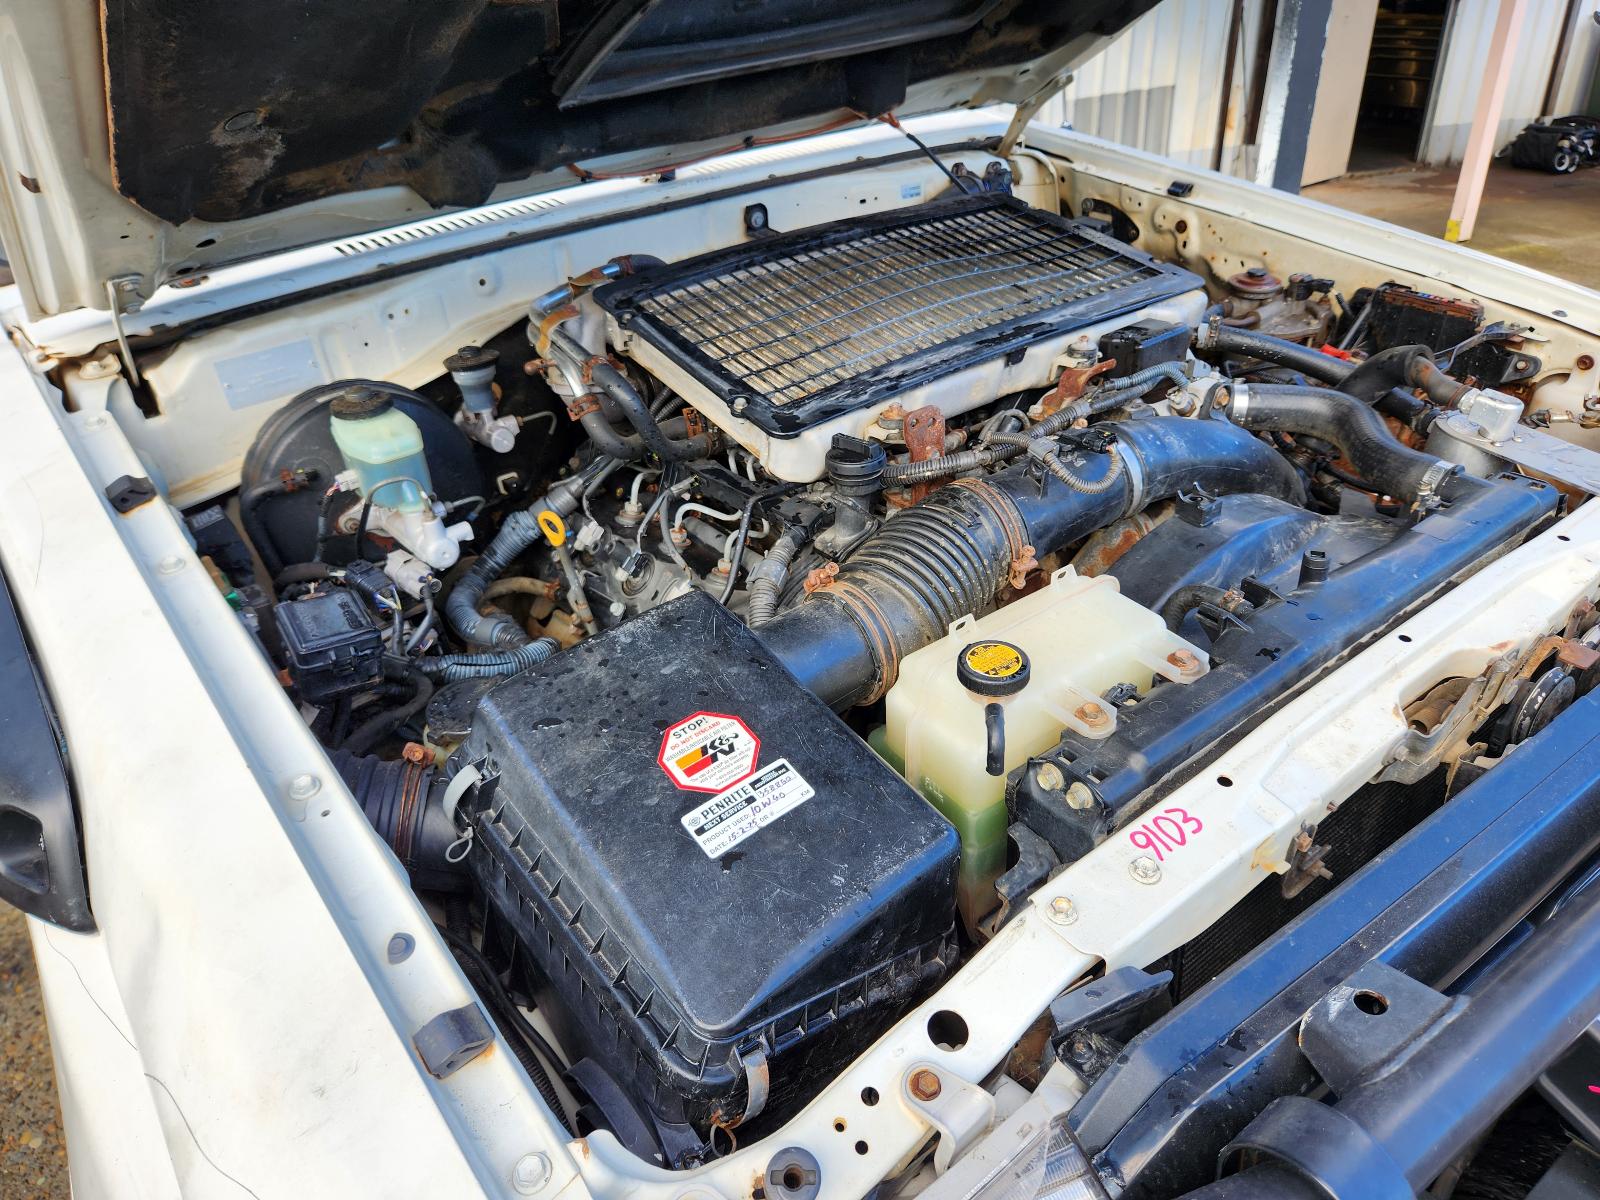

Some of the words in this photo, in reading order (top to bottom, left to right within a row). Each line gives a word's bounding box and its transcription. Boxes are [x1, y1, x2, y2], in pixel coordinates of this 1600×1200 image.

[670, 743, 680, 751] DO
[680, 735, 693, 745] NOT
[694, 721, 721, 738] DISCARD
[673, 717, 708, 739] STOP!
[701, 733, 739, 764] K&N
[700, 785, 751, 820] PENRITE
[703, 819, 721, 831] NEXT
[721, 800, 748, 819] SERVICE
[703, 824, 732, 846] PRODUCT
[732, 813, 751, 827] USED:
[709, 839, 729, 855] DATE:
[759, 814, 769, 823] OR
[800, 788, 811, 798] KM
[1129, 808, 1203, 861] 9103
